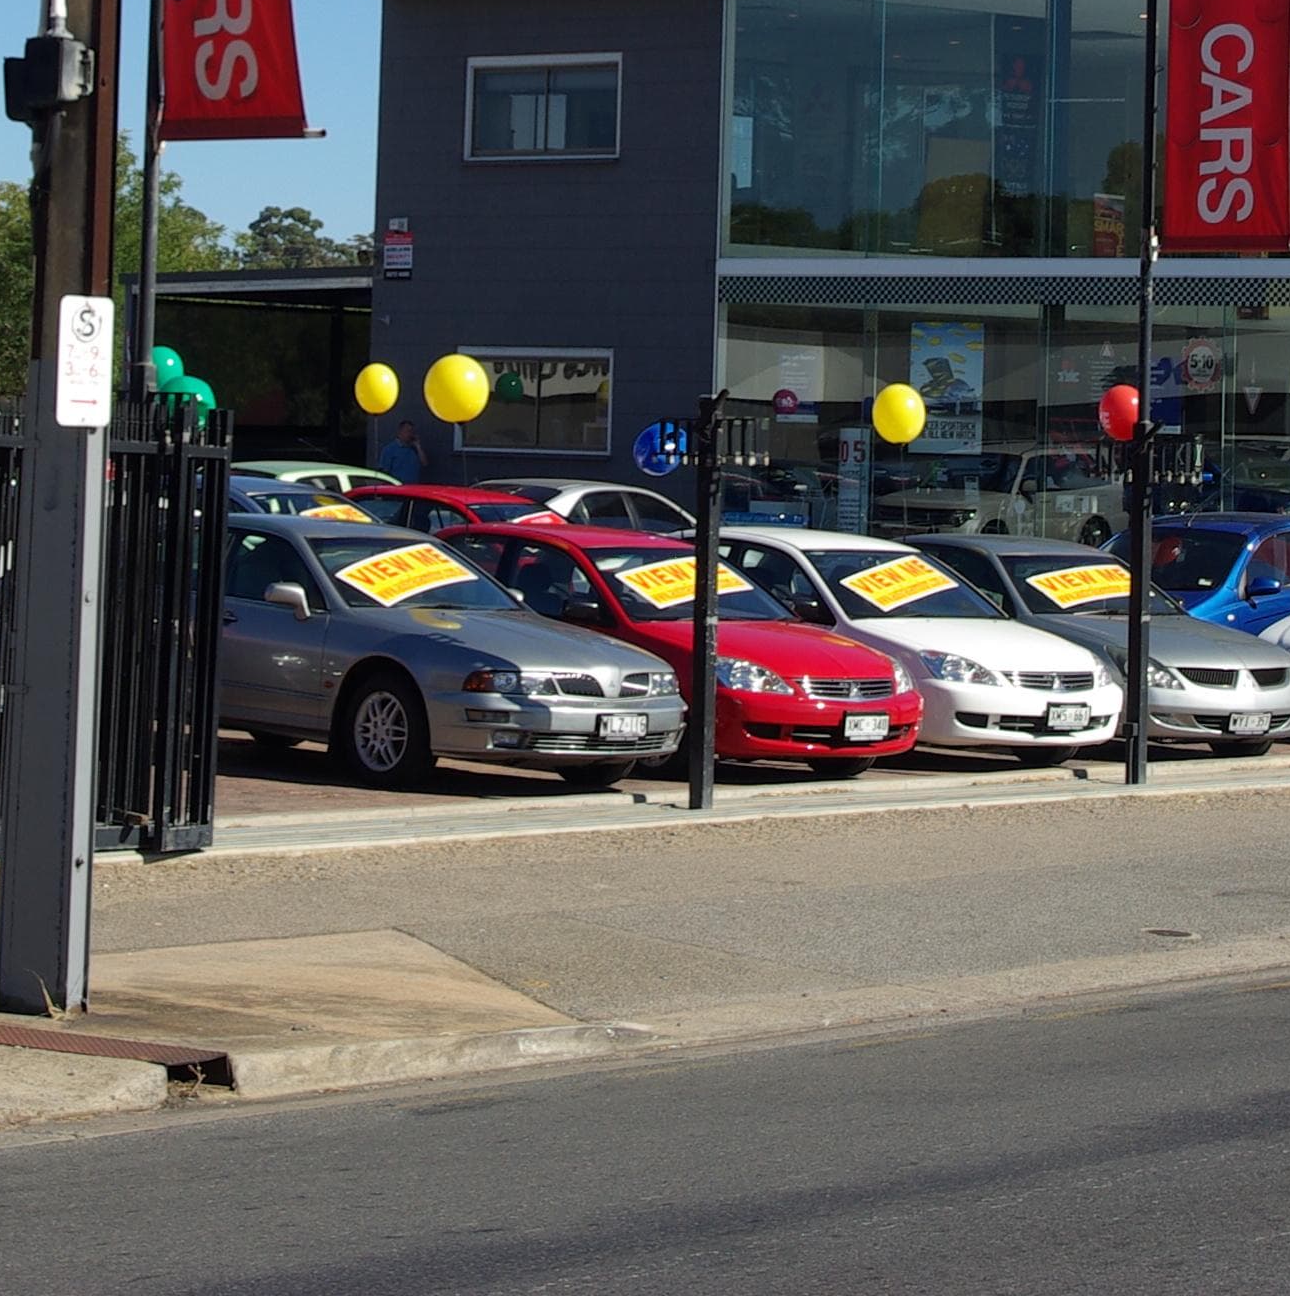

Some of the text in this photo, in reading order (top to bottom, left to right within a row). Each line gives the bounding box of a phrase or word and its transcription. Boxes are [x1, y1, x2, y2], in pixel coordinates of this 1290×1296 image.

[1197, 23, 1254, 224] CARS
[347, 554, 414, 585] VIEW
[410, 548, 450, 568] ME
[626, 563, 691, 589] VIEW
[849, 567, 906, 593] VIEW
[1035, 570, 1097, 592] VIEW
